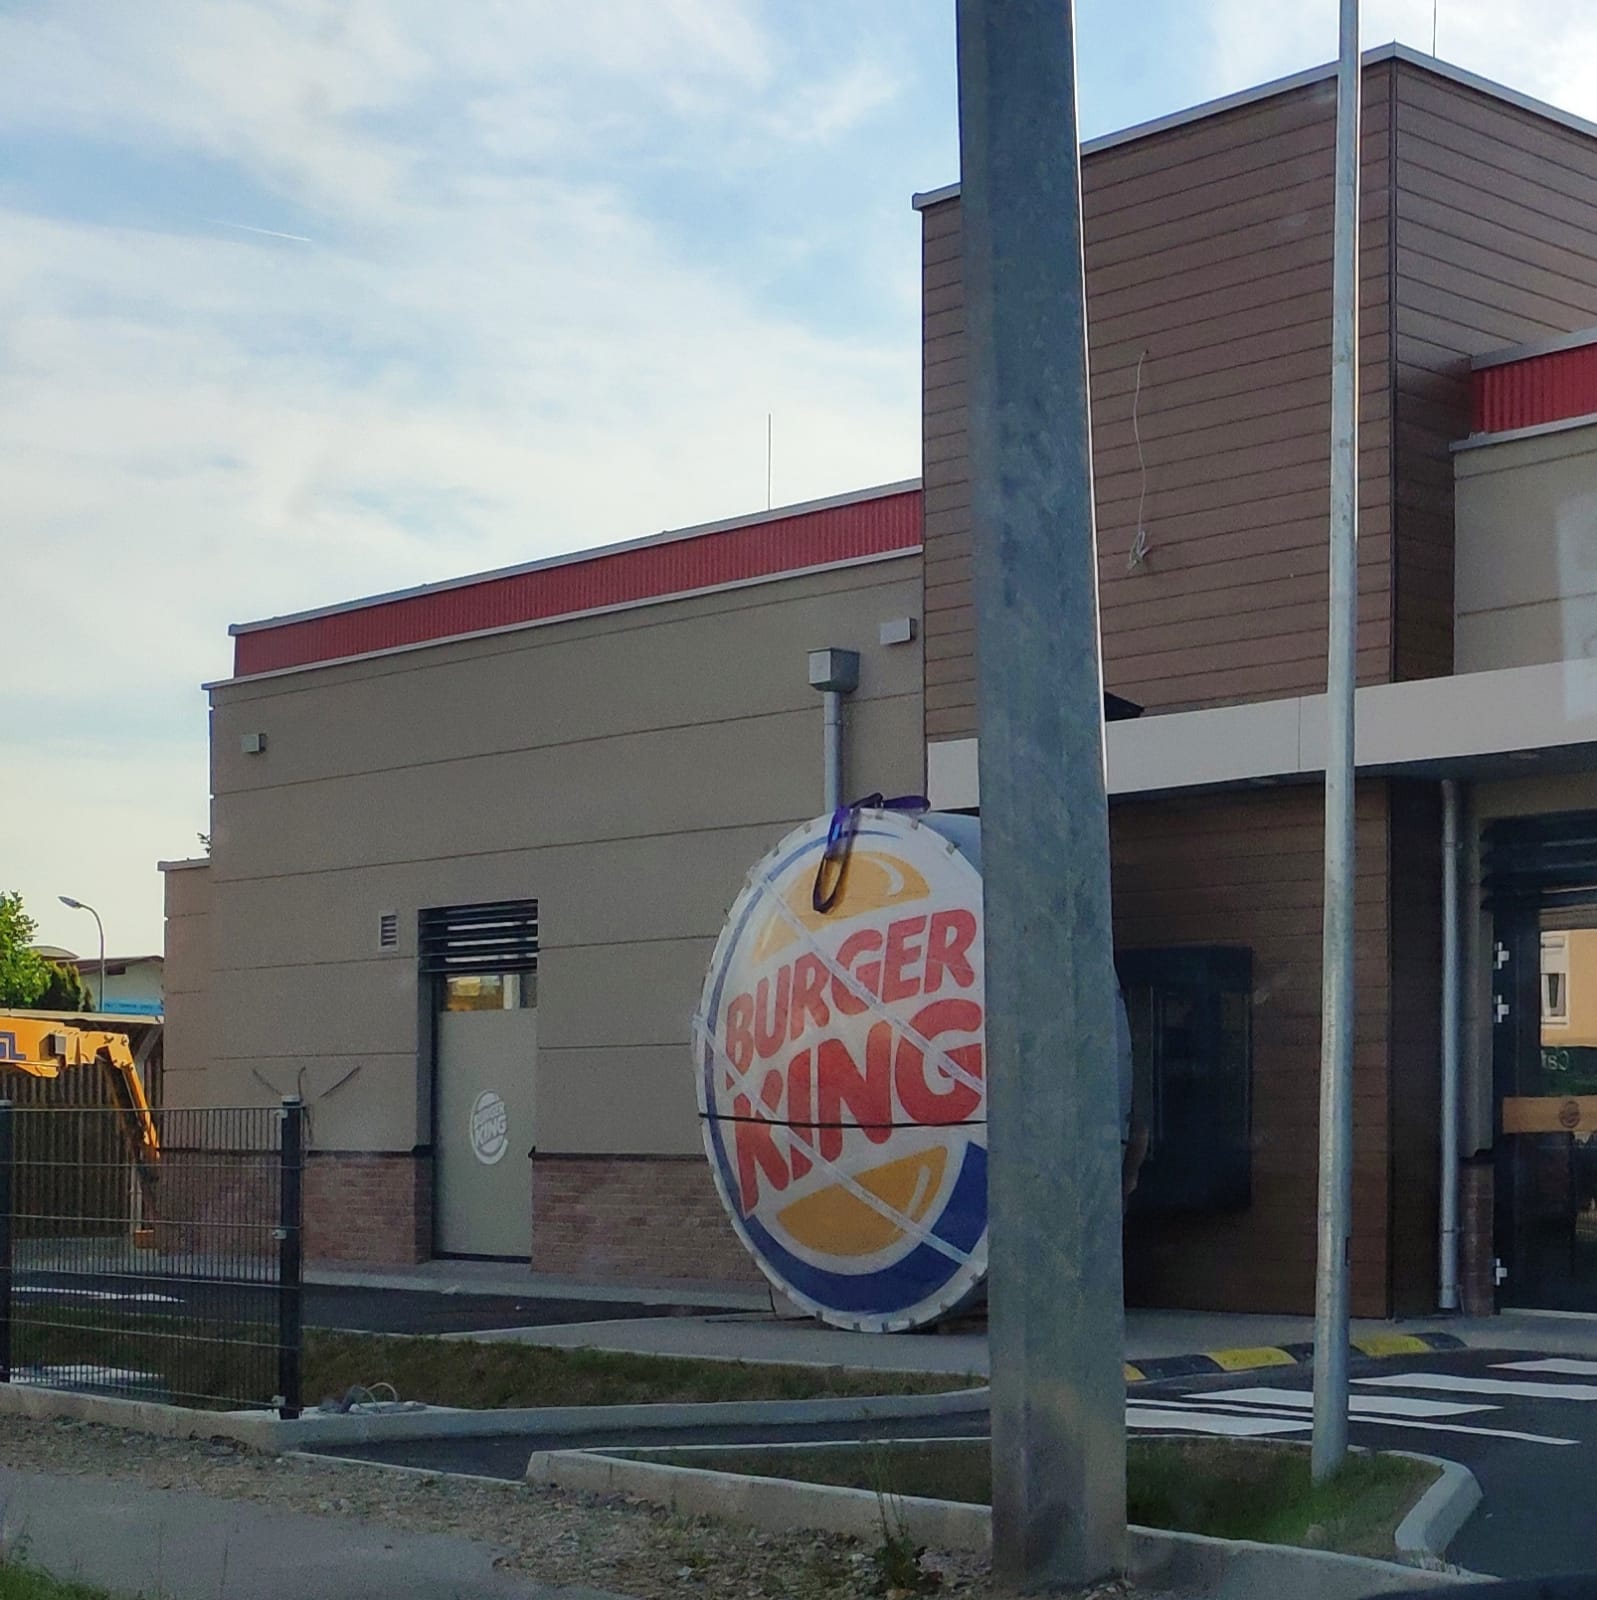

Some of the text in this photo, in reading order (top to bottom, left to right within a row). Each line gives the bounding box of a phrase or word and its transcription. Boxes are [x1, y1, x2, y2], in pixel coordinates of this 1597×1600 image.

[726, 909, 977, 1089] BURGER
[474, 1115, 507, 1148] KING
[733, 999, 982, 1219] KING
